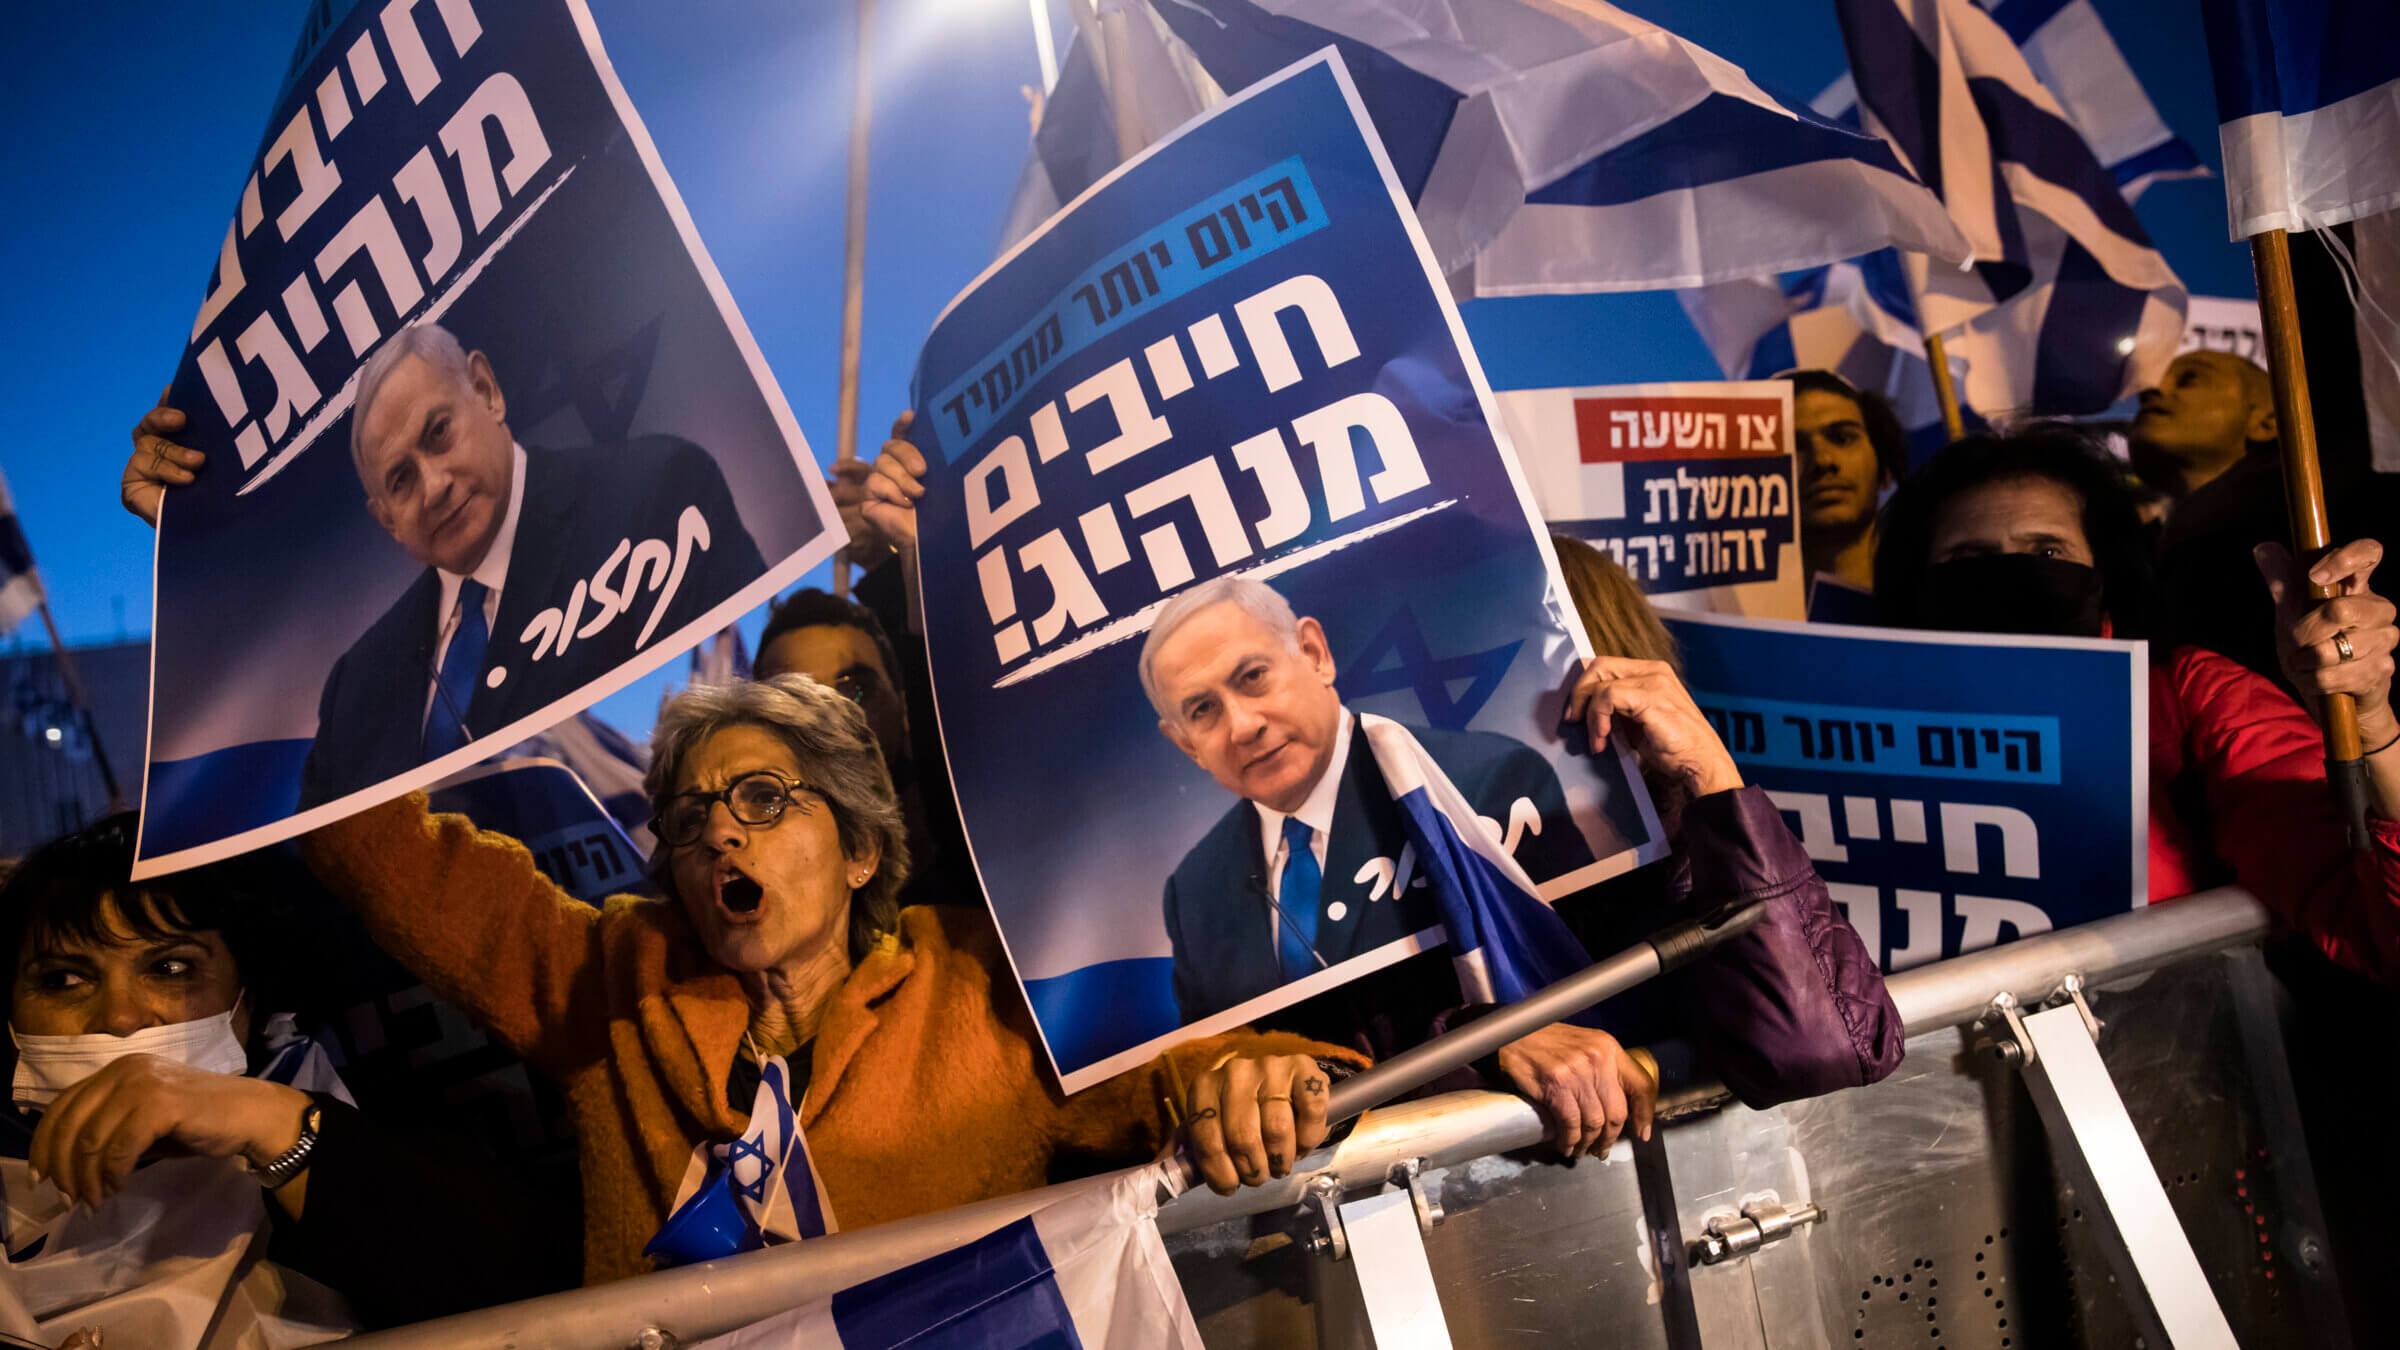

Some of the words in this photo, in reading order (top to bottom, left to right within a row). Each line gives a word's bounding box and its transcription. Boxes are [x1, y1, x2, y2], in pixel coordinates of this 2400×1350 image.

[1184, 175, 1308, 271] היום
[196, 71, 553, 471] מנהיג!
[1071, 240, 1174, 327] יותר
[941, 311, 1064, 438] מתמיד
[963, 274, 1362, 551] חייבים
[1609, 410, 1728, 450] השעה
[1736, 414, 1778, 451] צו
[976, 391, 1432, 666] מנהיג!
[1642, 466, 1790, 525] ממשלת
[1683, 528, 1768, 577] זהות
[1783, 716, 1896, 764] יותר
[1916, 724, 2043, 774] היום
[1764, 789, 2041, 880] חייב
